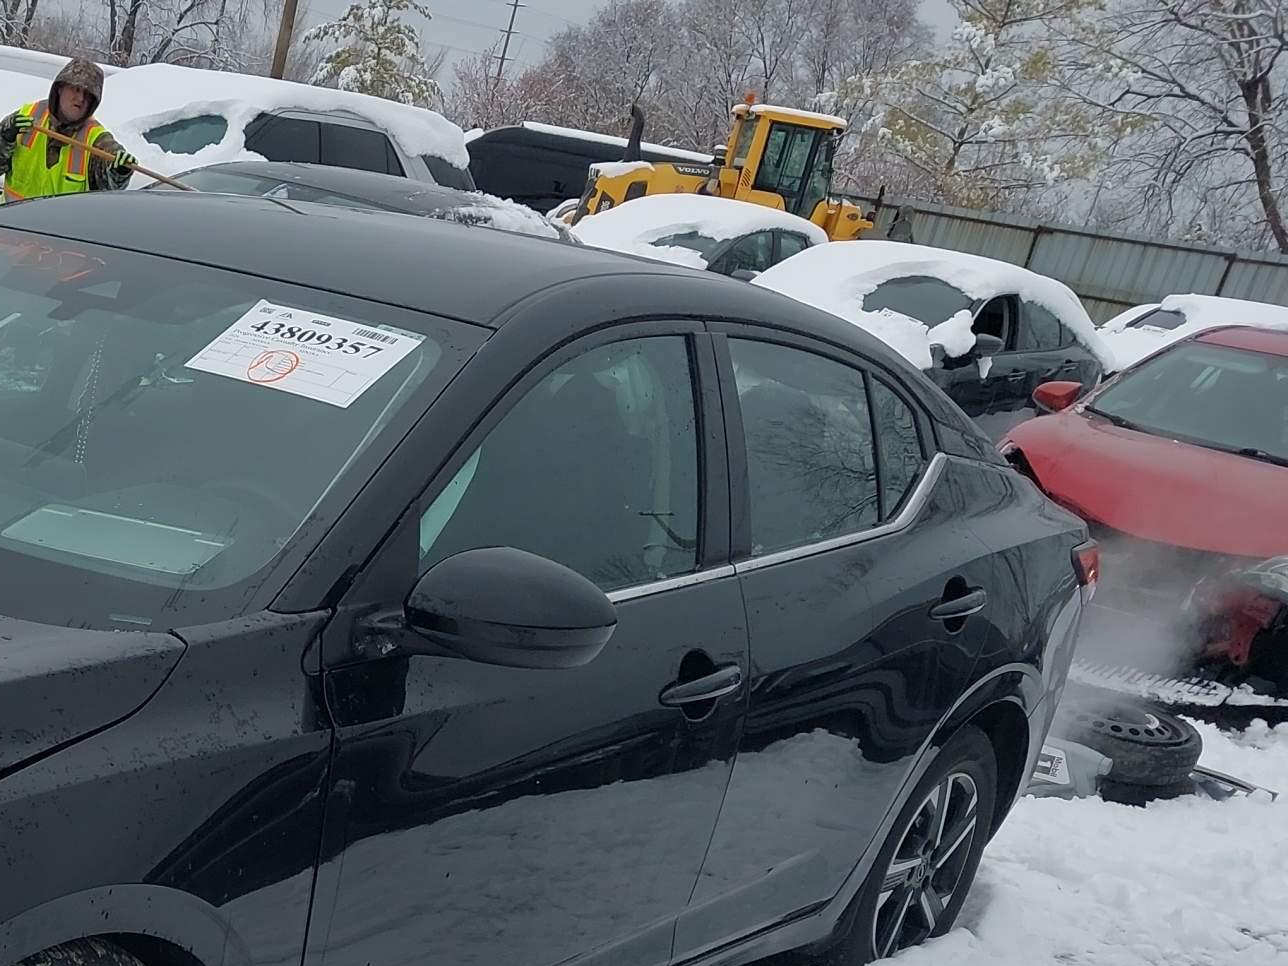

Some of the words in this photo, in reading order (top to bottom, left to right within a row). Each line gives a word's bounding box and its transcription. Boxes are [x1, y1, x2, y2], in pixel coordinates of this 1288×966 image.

[677, 166, 710, 175] VOLVO
[251, 319, 384, 359] 43809357
[1050, 756, 1063, 777] Mobil
